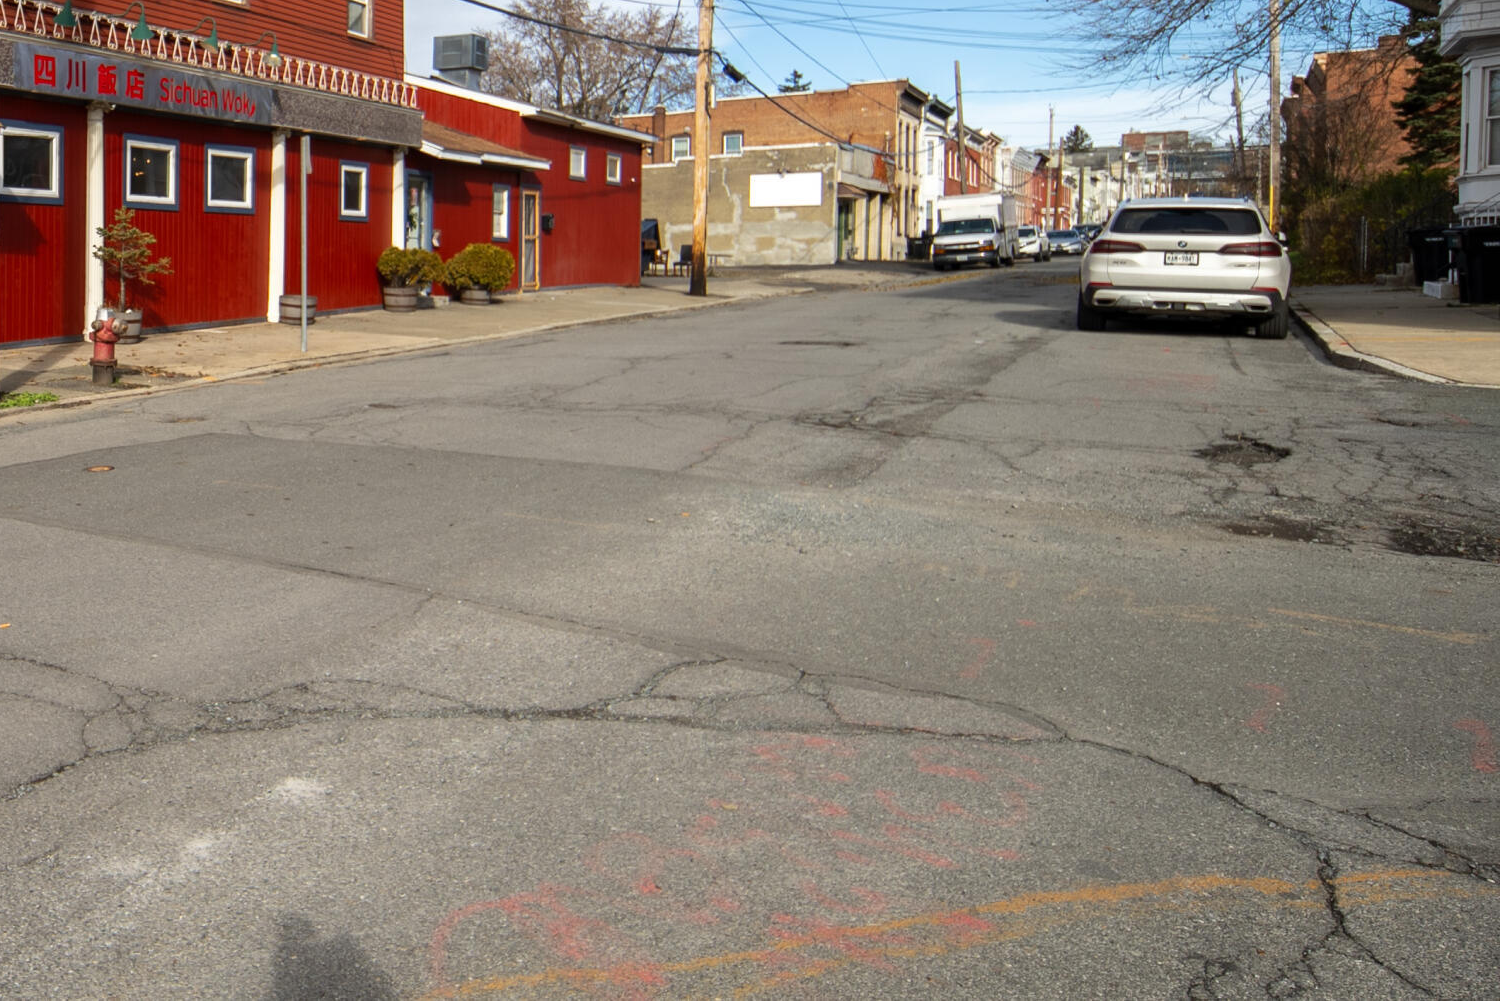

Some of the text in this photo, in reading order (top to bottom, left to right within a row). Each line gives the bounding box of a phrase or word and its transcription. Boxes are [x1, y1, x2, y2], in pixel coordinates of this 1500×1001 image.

[34, 54, 145, 100] 四川飯店
[160, 77, 251, 116] Sichuan Wok
